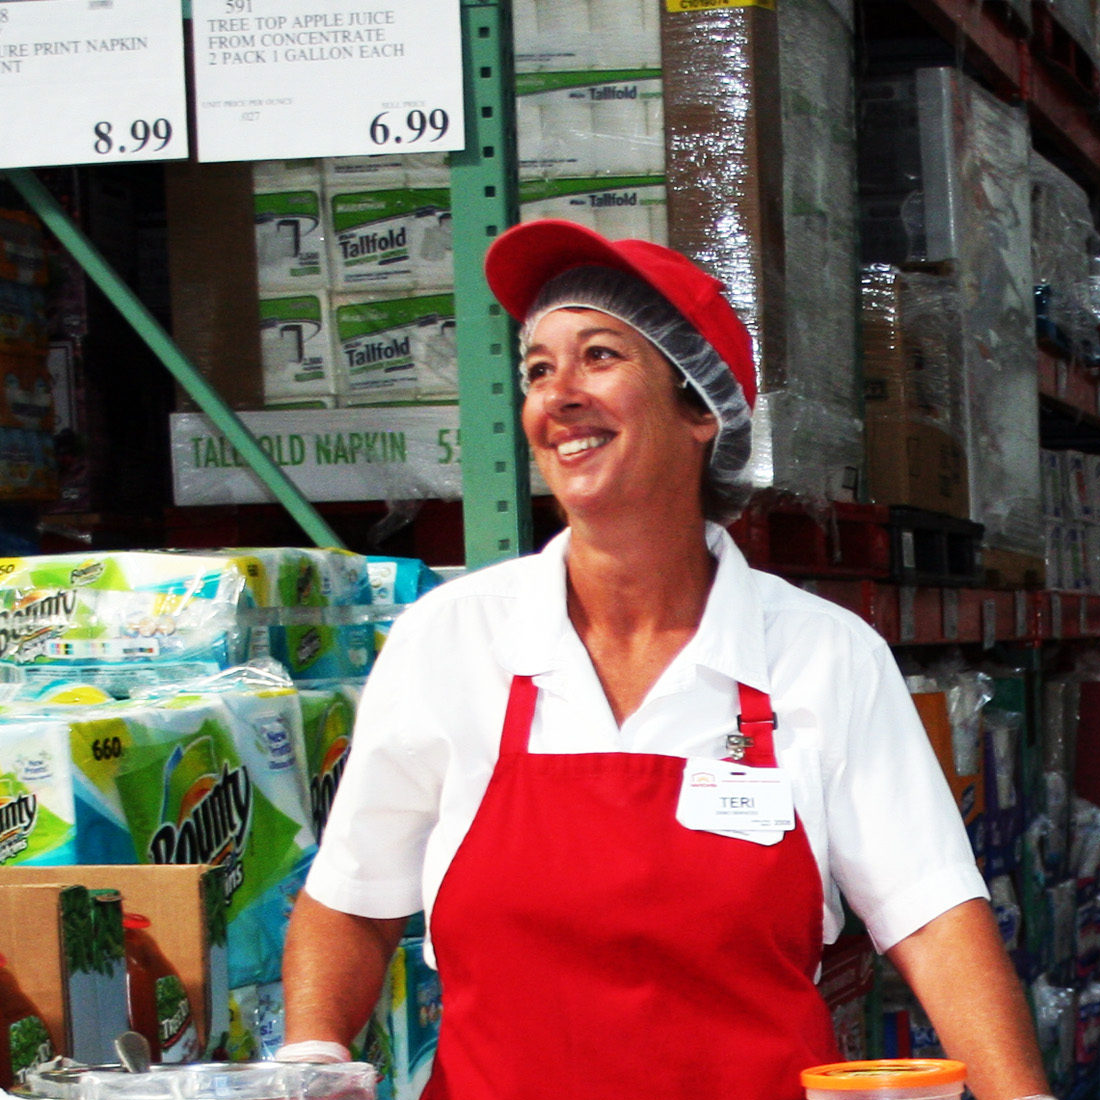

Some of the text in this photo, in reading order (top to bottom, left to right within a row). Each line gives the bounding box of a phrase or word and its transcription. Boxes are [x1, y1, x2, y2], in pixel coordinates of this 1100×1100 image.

[208, 11, 395, 32] TREE TOP APPLE JUICE
[34, 41, 81, 56] PRINT
[86, 37, 148, 53] NAPKIN
[208, 29, 386, 49] FROM CONCENTRATE
[209, 44, 404, 65] 2 PACK 1 GALLON EACH
[588, 86, 637, 99] Tallfold
[94, 118, 173, 154] 8.99
[370, 108, 450, 146] 6.99
[588, 193, 637, 207] Tallfold
[339, 227, 407, 259] Tallfold
[343, 336, 410, 367] Tallfold
[191, 433, 305, 468] TALLOLD
[315, 431, 407, 465] NAPKIN
[92, 737, 122, 761] 660
[720, 797, 755, 808] TERI
